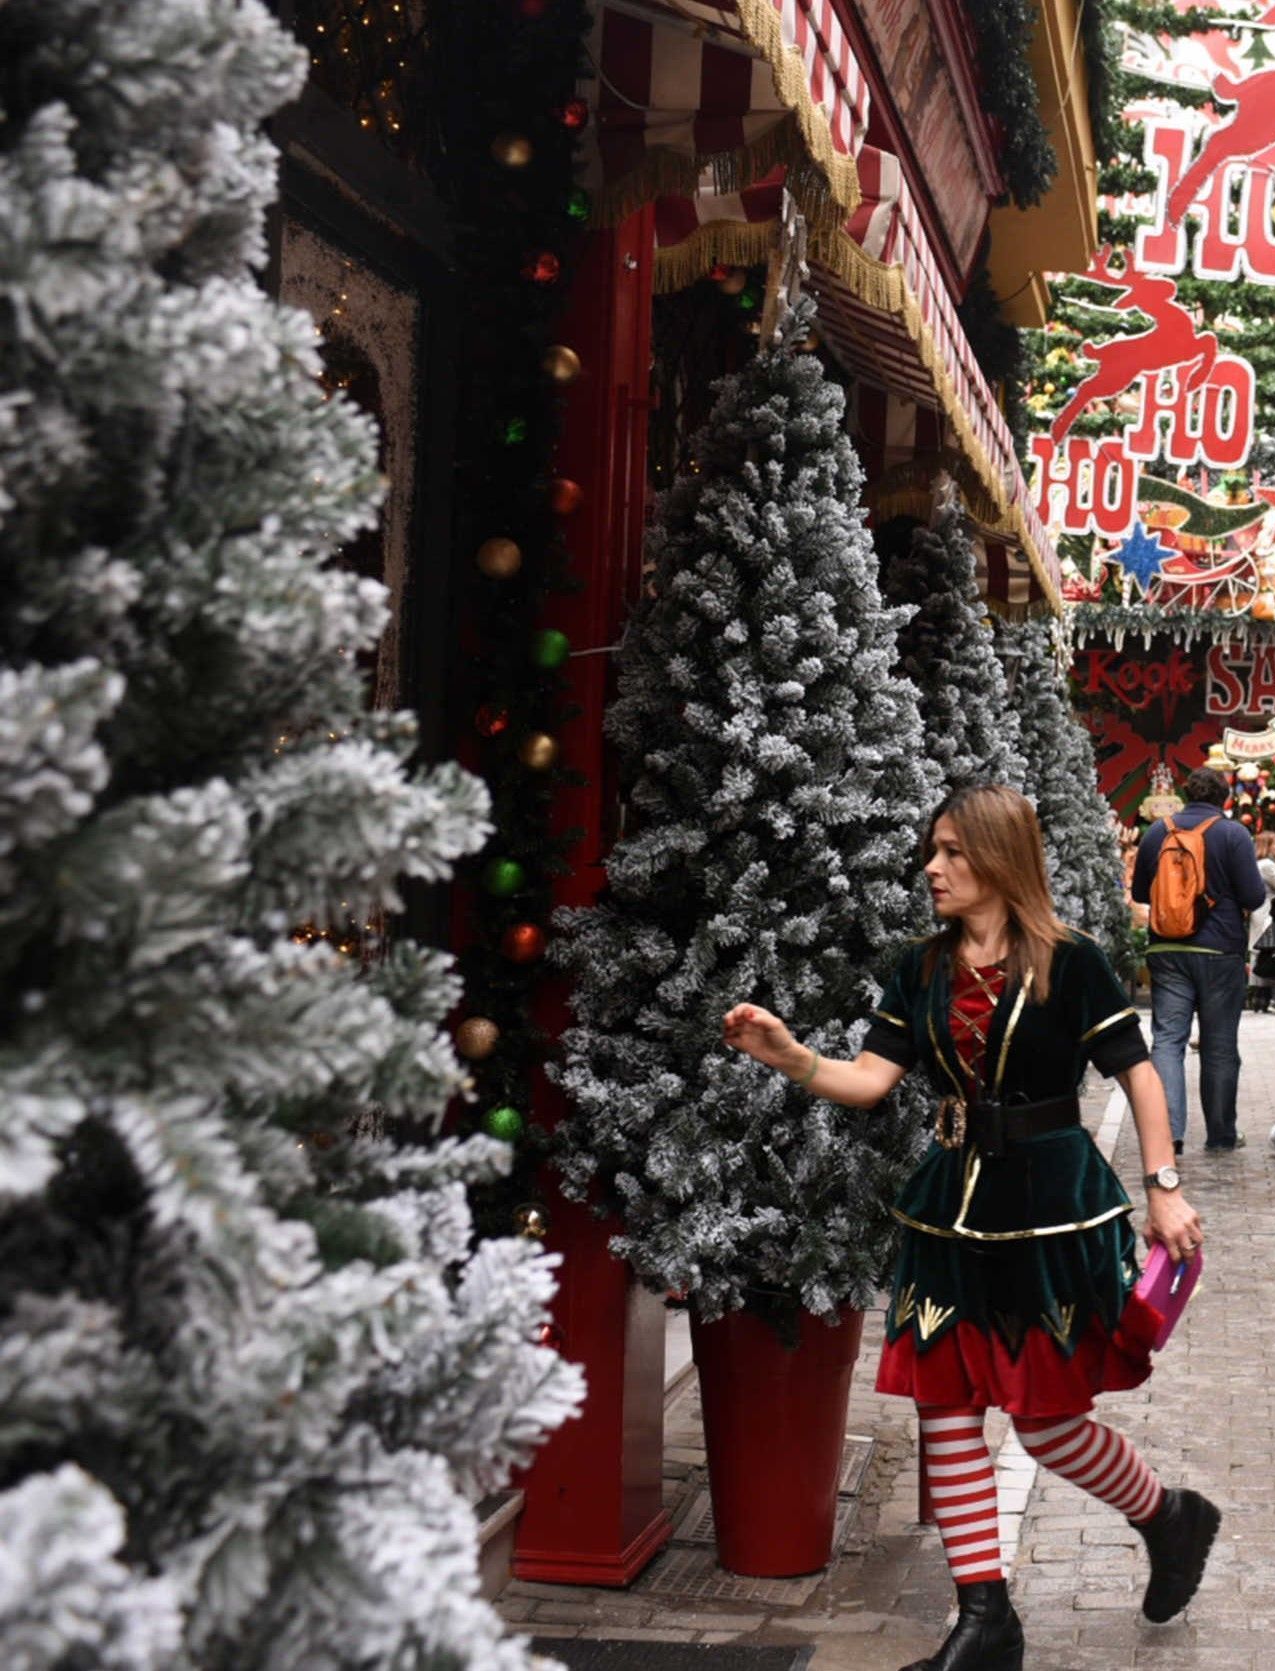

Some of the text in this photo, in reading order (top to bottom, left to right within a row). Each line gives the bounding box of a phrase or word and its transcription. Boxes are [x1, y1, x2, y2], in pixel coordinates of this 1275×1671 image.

[1124, 354, 1256, 468] HO
[1030, 434, 1139, 536] HO
[1074, 649, 1194, 709] Kook
